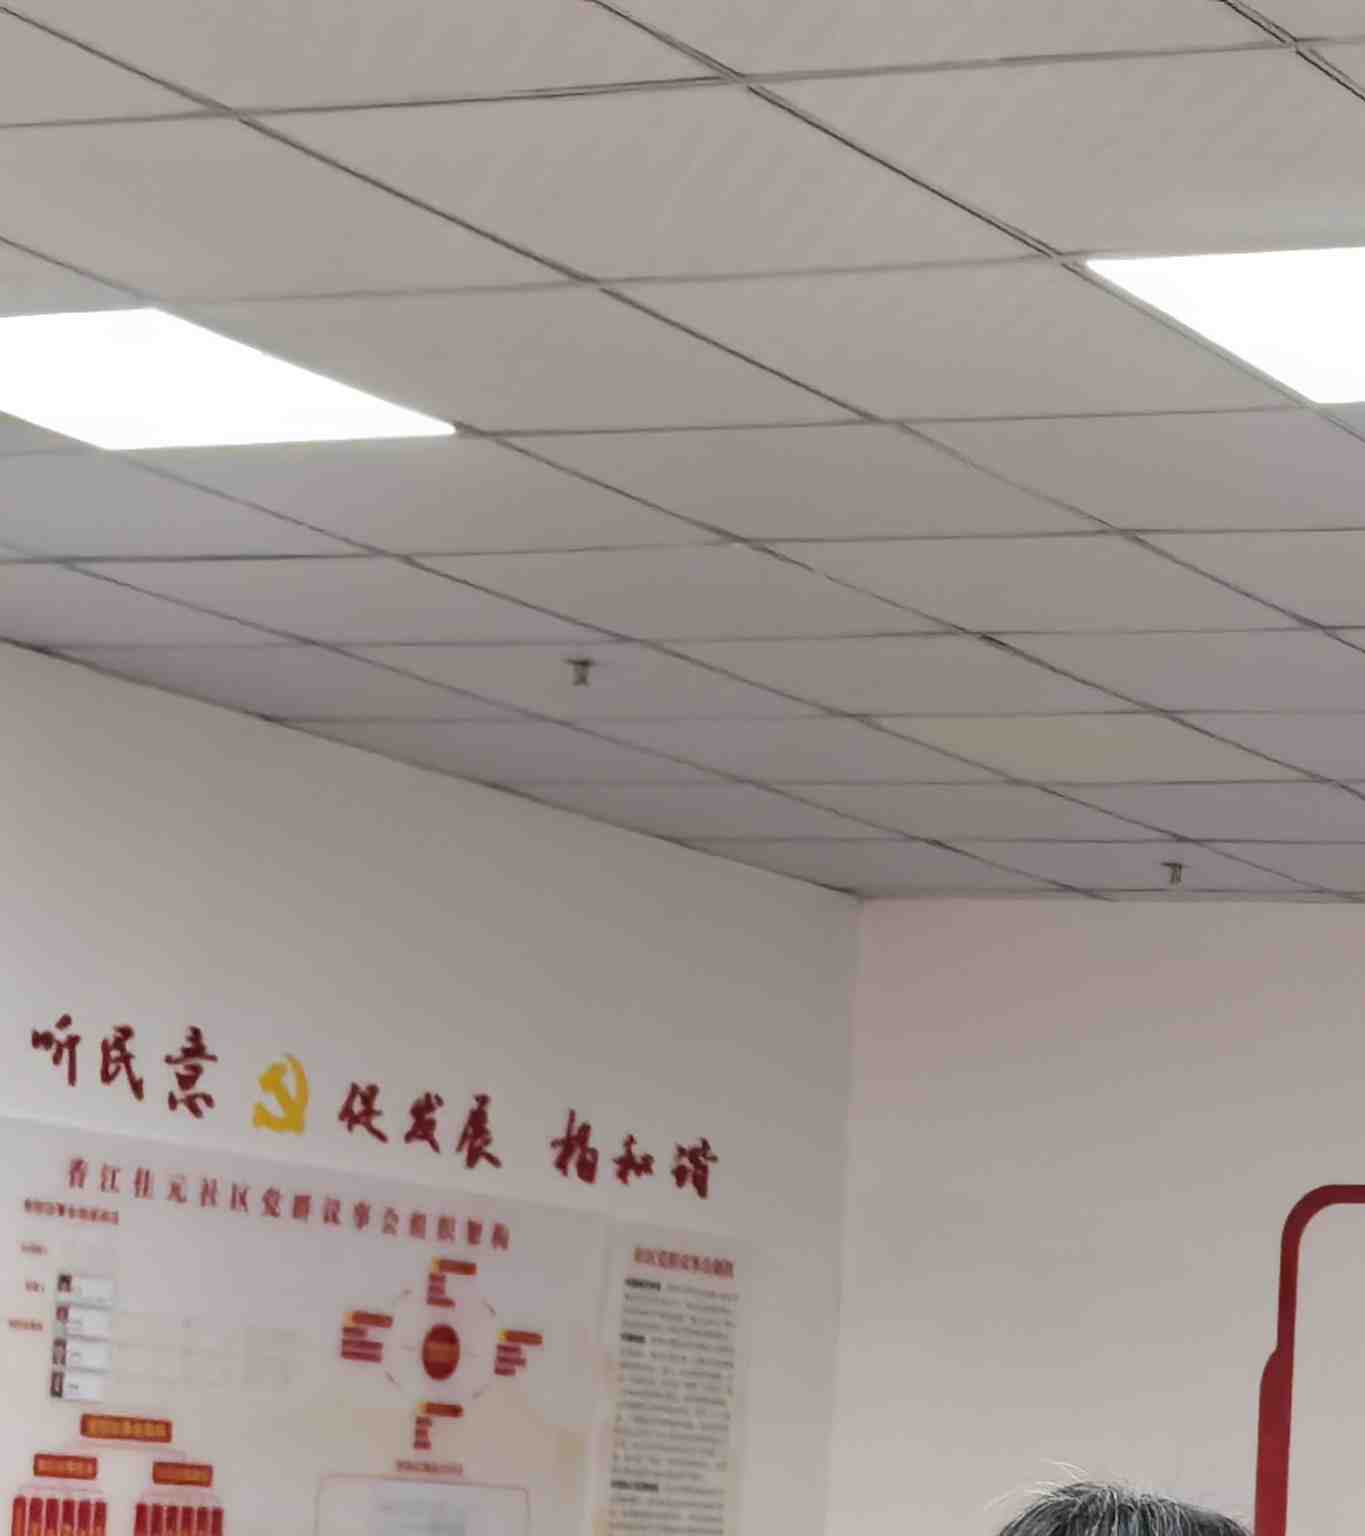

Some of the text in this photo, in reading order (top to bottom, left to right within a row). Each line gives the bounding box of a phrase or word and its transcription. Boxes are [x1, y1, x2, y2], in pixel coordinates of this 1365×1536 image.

[32, 1014, 218, 1118] 听民意
[339, 1083, 501, 1168] 促发展
